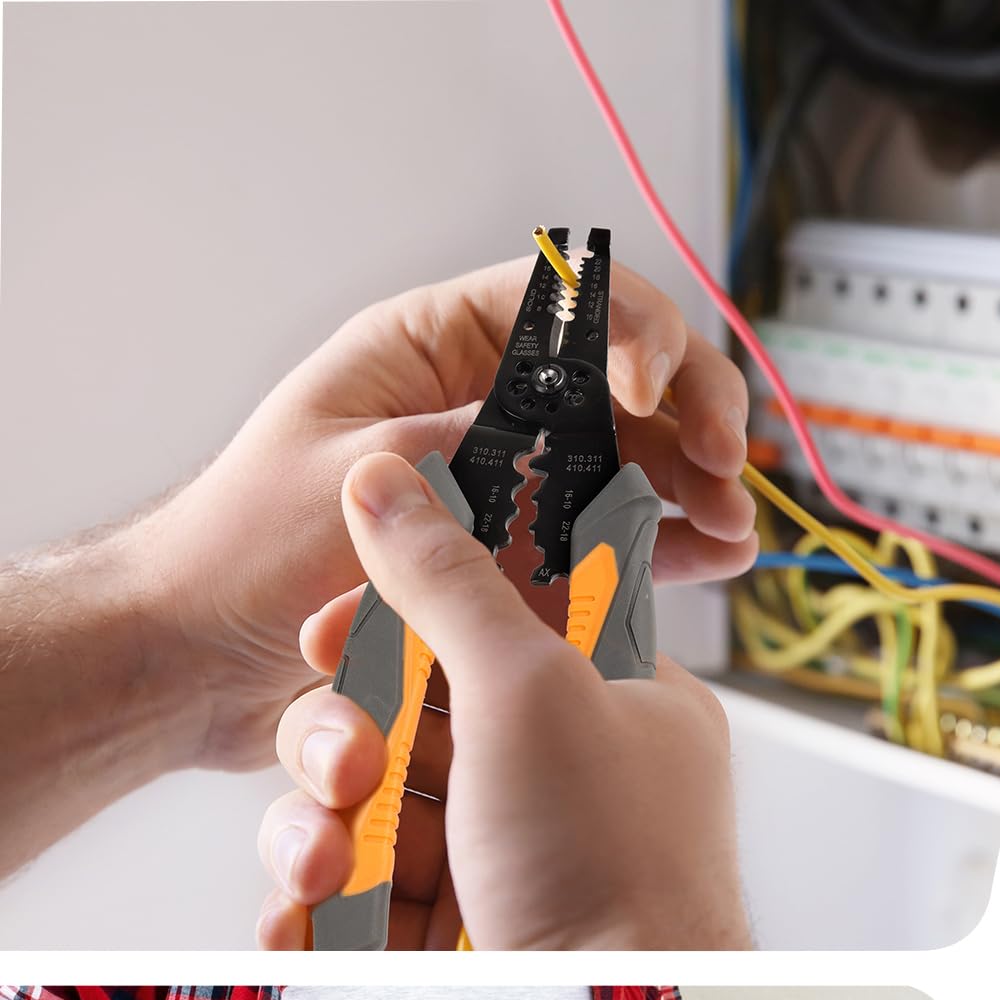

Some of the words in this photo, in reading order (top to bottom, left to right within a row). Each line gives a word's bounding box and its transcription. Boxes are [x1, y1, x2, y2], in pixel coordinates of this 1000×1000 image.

[472, 446, 506, 458] 310.311
[470, 456, 504, 468] 410.411
[567, 454, 602, 463] 310.311
[566, 464, 602, 472] 410.411
[562, 489, 574, 510] 16-10
[560, 520, 571, 542] 22-18
